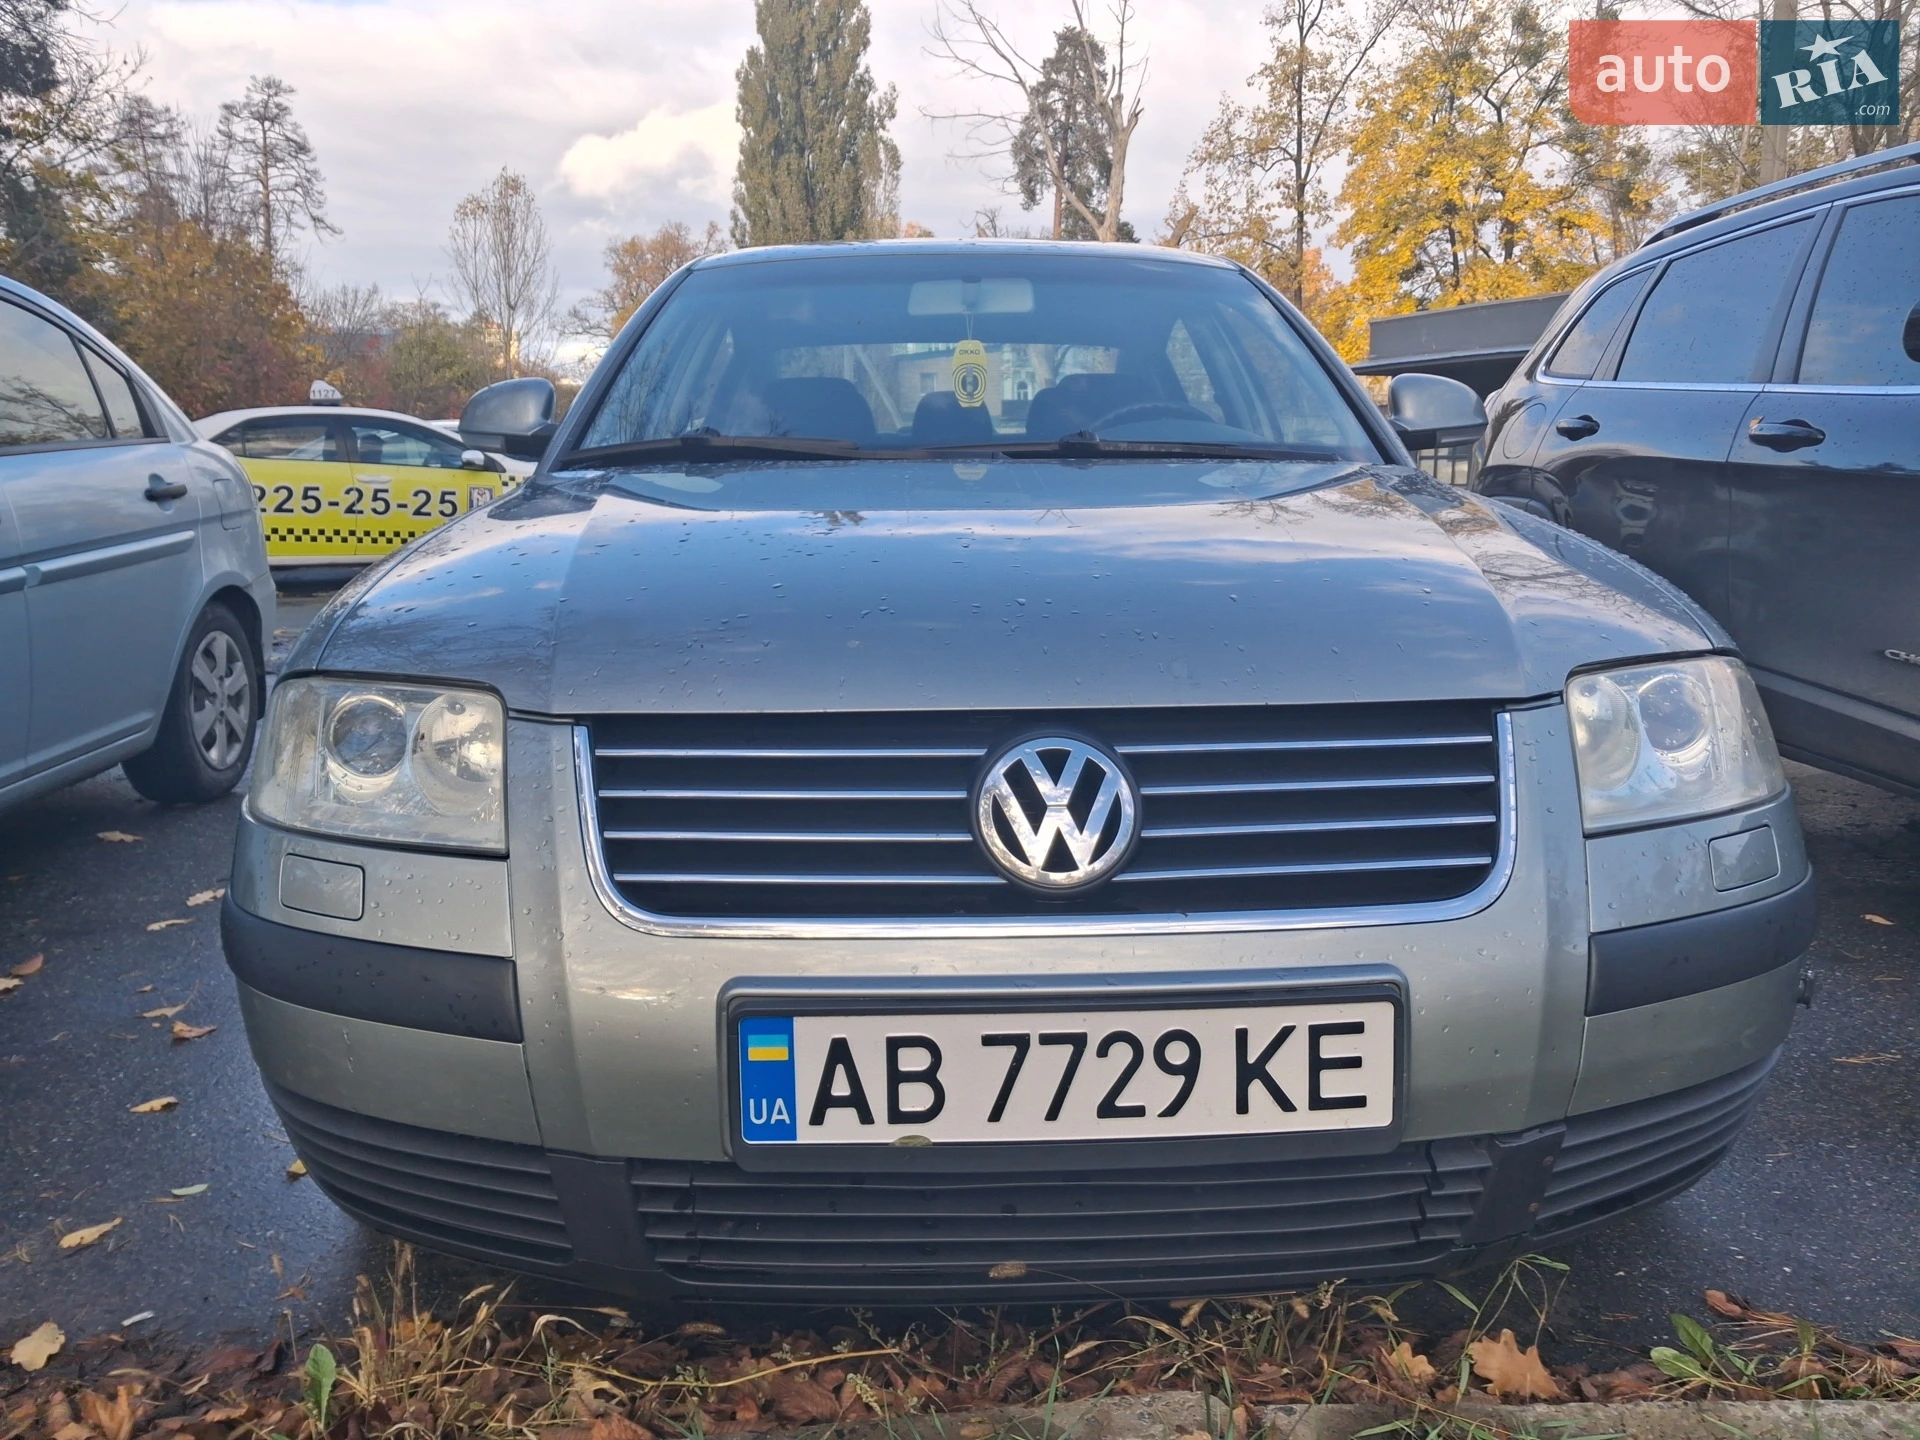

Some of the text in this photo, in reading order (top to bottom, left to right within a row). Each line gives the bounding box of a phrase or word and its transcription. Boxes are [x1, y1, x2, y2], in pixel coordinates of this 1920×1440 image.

[312, 389, 336, 398] 1127
[978, 737, 1135, 889] VW
[808, 1021, 1367, 1126] AB 7729 KE
[749, 1097, 791, 1125] UA
